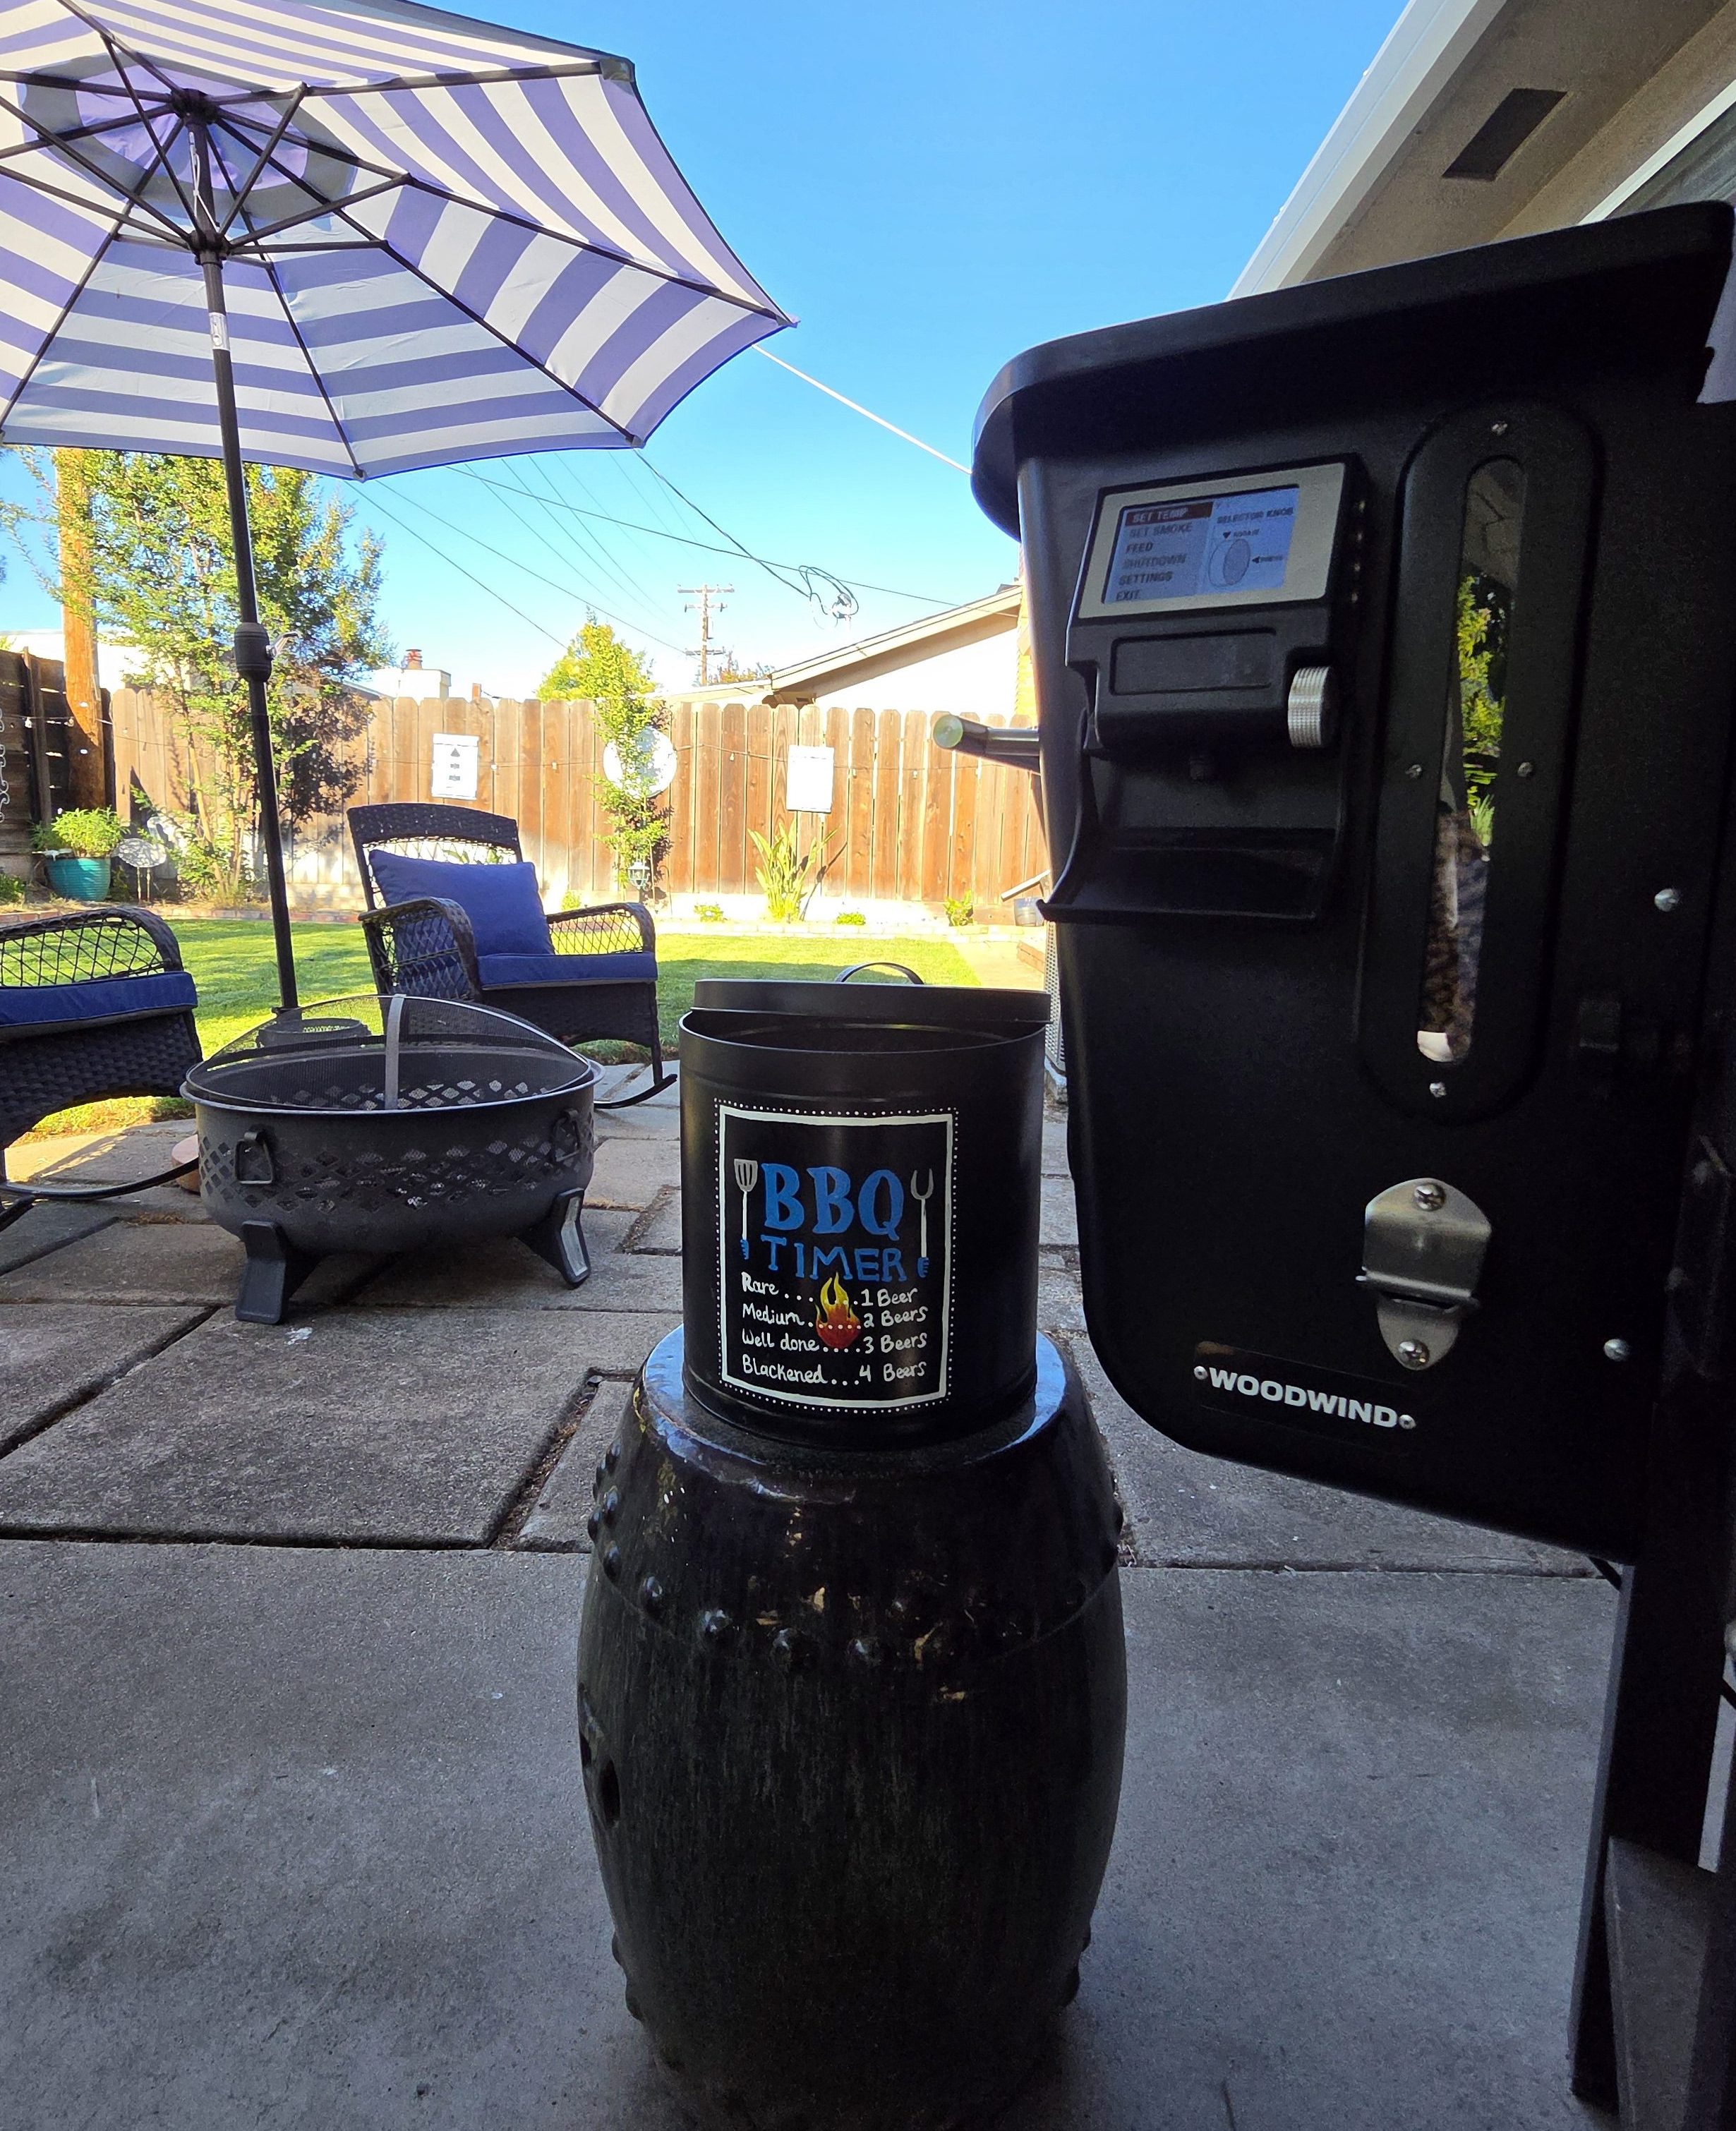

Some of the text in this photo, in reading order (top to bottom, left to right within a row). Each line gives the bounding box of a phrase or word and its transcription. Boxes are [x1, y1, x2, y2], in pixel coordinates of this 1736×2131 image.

[1133, 508, 1187, 522] SET TEMP
[1130, 522, 1193, 538] SET SMOKE
[1126, 542, 1154, 554] FEED
[1119, 571, 1173, 585] SETTINGS
[1116, 590, 1140, 601] EXIT
[761, 1163, 905, 1240] BBQ
[760, 1234, 908, 1282] TIMER
[877, 1288, 918, 1307] Beer
[881, 1305, 928, 1327] Beers
[742, 1329, 775, 1348] Well
[880, 1330, 928, 1353] Beers
[883, 1360, 927, 1382] Beers
[1209, 1367, 1398, 1428] WOODWIND
